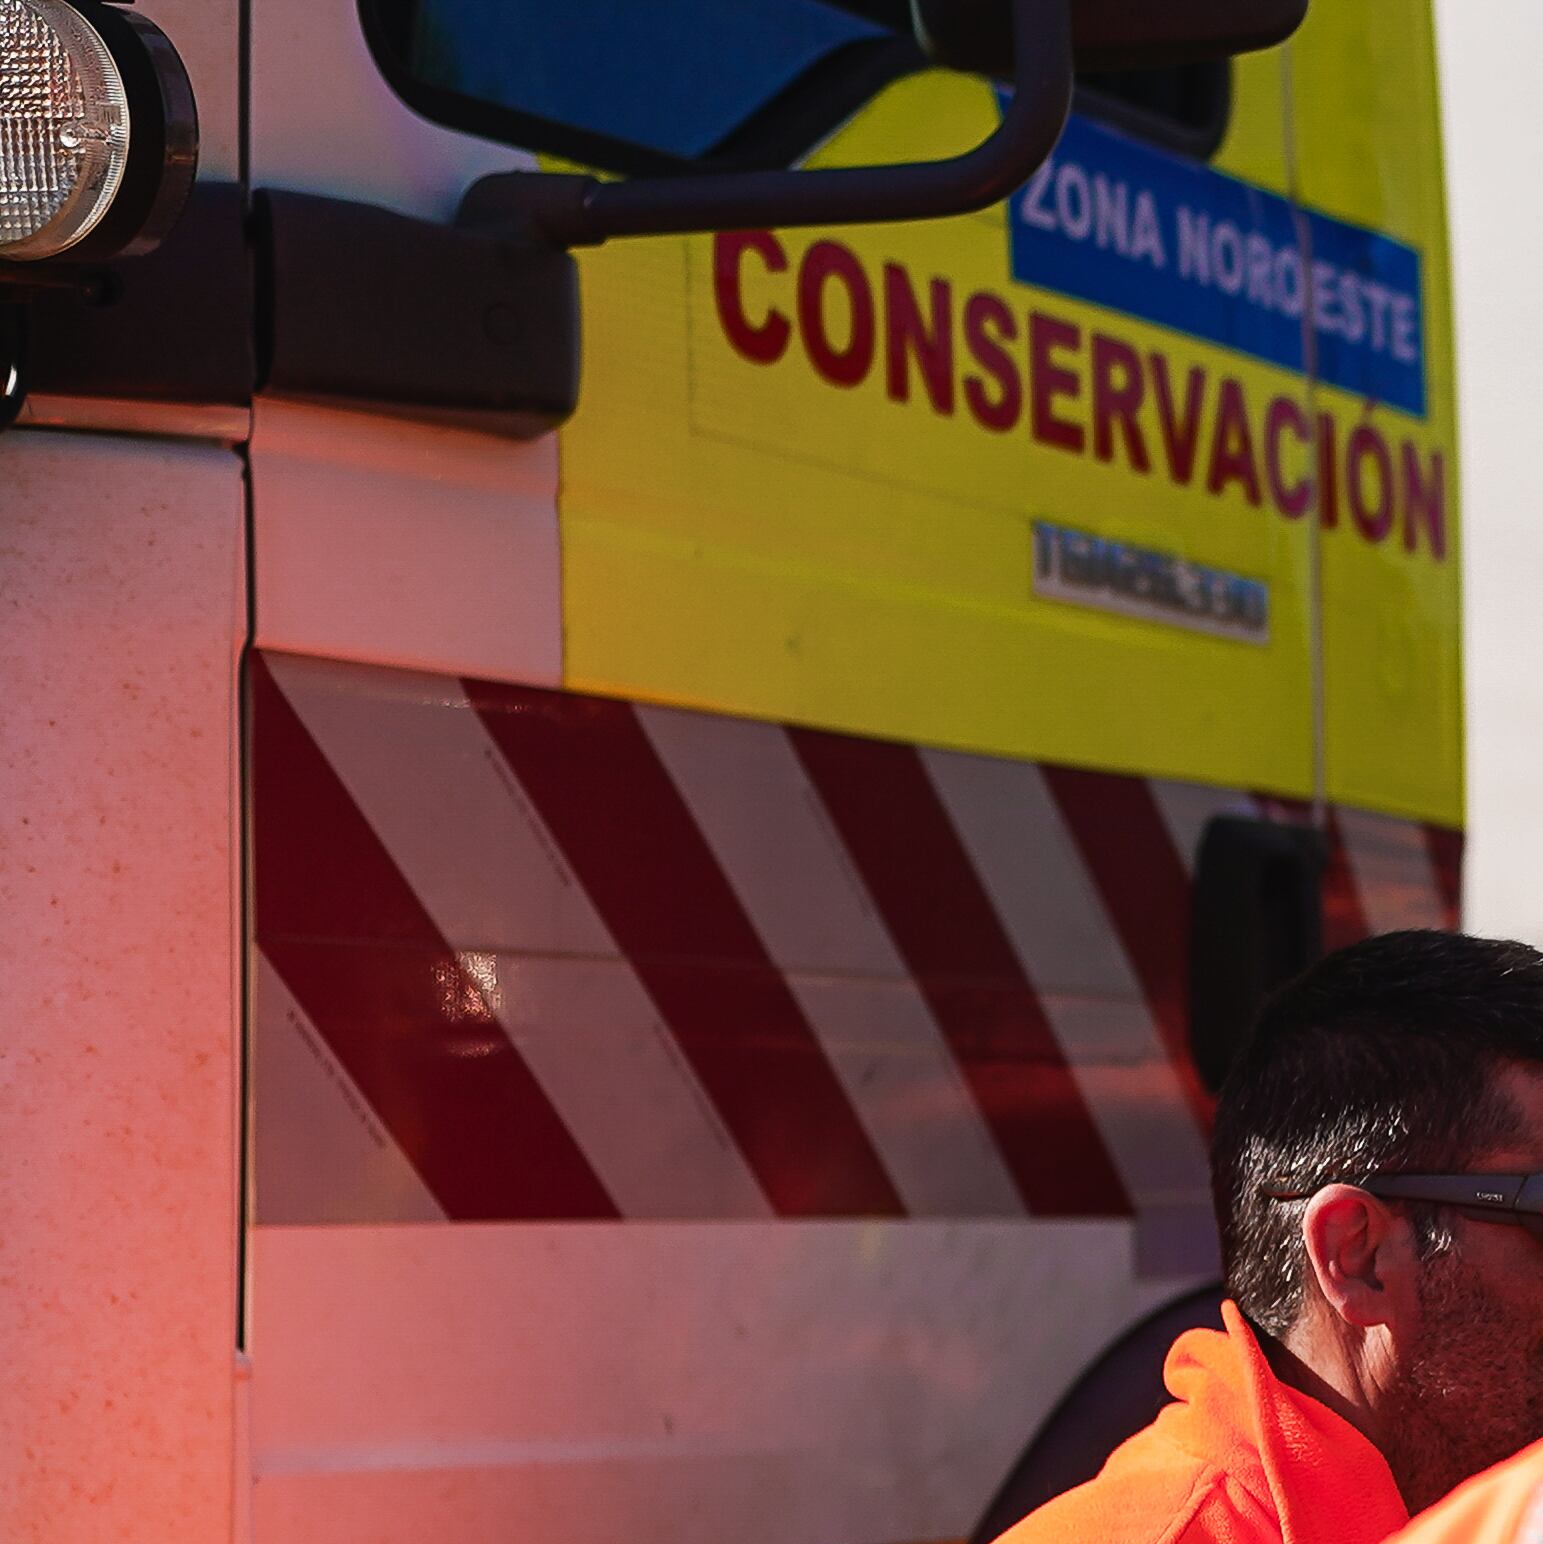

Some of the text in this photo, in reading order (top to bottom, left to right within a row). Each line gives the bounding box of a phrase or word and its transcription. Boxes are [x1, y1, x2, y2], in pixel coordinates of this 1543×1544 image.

[1019, 156, 1418, 362] ZONA NOROESTE
[713, 229, 1447, 563] CONSERVACIÓN
